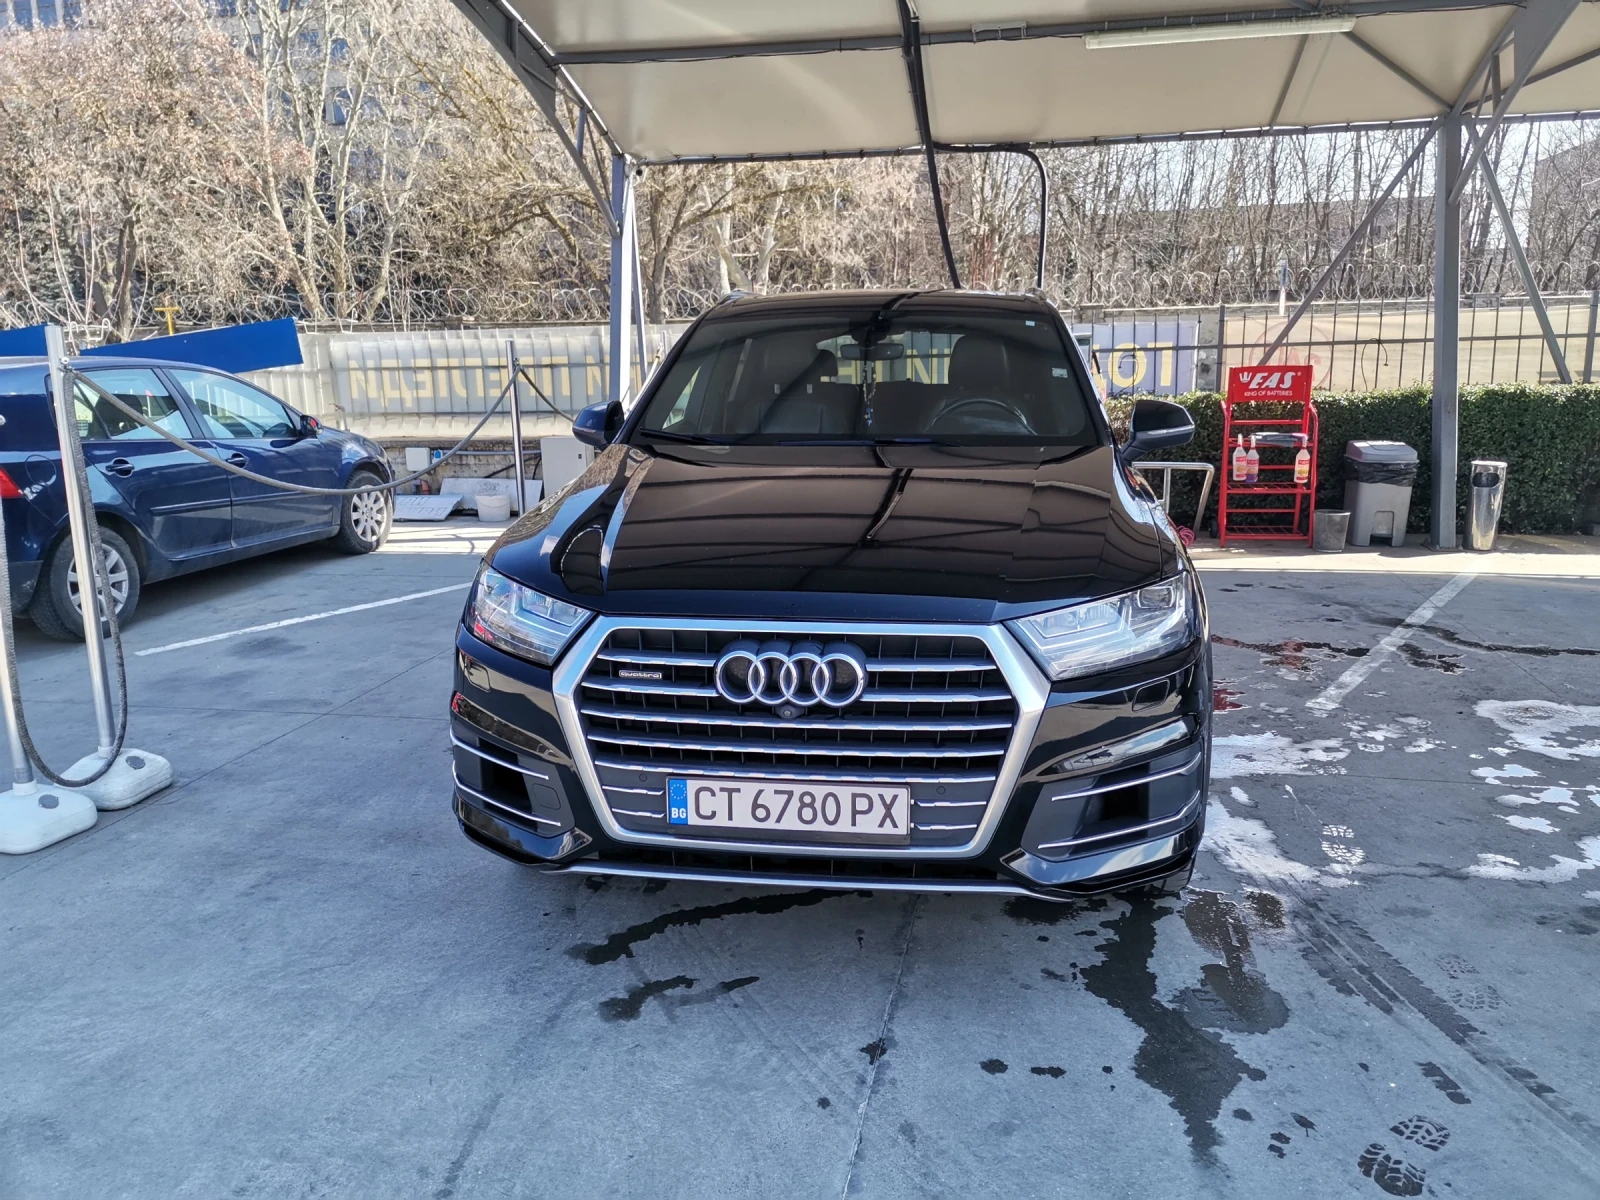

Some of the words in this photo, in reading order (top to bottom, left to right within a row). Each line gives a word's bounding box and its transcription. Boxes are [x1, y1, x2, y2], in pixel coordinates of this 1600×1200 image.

[619, 671, 661, 679] quattro
[671, 807, 687, 820] BG
[694, 786, 741, 821] CT
[751, 789, 842, 826] 6780
[850, 793, 899, 829] PX
